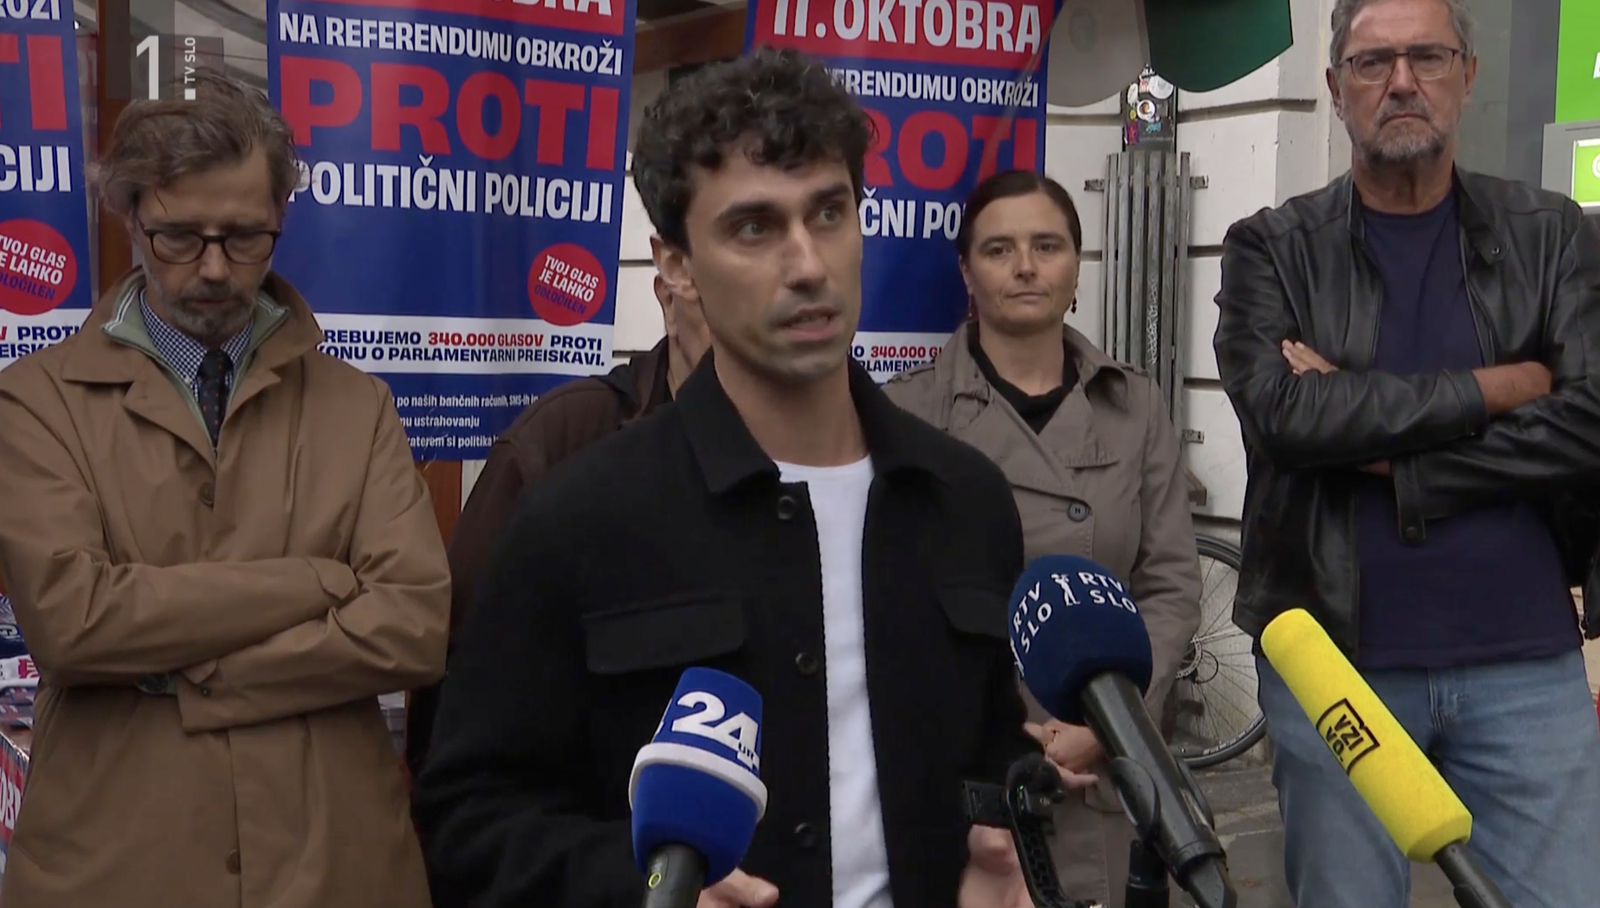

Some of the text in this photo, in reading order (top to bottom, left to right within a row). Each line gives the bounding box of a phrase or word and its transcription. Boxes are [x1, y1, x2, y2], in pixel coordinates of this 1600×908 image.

[279, 12, 623, 76] NA REFERENDUMU OBKROŽI
[961, 76, 1039, 108] OBKROŽI
[279, 55, 620, 171] PROTI
[485, 172, 613, 223] POLICIJI
[858, 186, 967, 240] ČNI PO
[9, 257, 63, 285] LAHKO
[30, 246, 67, 269] GLAS
[544, 254, 599, 289] TVOJ GLAS
[534, 284, 587, 315] ODLOČILEN
[538, 268, 594, 302] JE LAHKO
[321, 329, 602, 351] REBUJEMO 340.000 GLASOV PROTI
[870, 345, 926, 359] 340.000
[371, 346, 385, 360] O
[388, 347, 516, 362] PARLAMENTARNI
[518, 349, 605, 367] PREISKAVI.
[396, 396, 410, 409] po
[411, 394, 438, 407] naših
[439, 394, 480, 407] bančnih
[414, 415, 480, 429] ustrahovanju
[407, 435, 445, 448] aterem
[446, 435, 456, 448] si
[458, 434, 493, 449] politika
[1078, 571, 1124, 593] RTV
[1012, 581, 1041, 634] RTV
[1089, 589, 1138, 614] SLO
[1020, 602, 1053, 654] SLO
